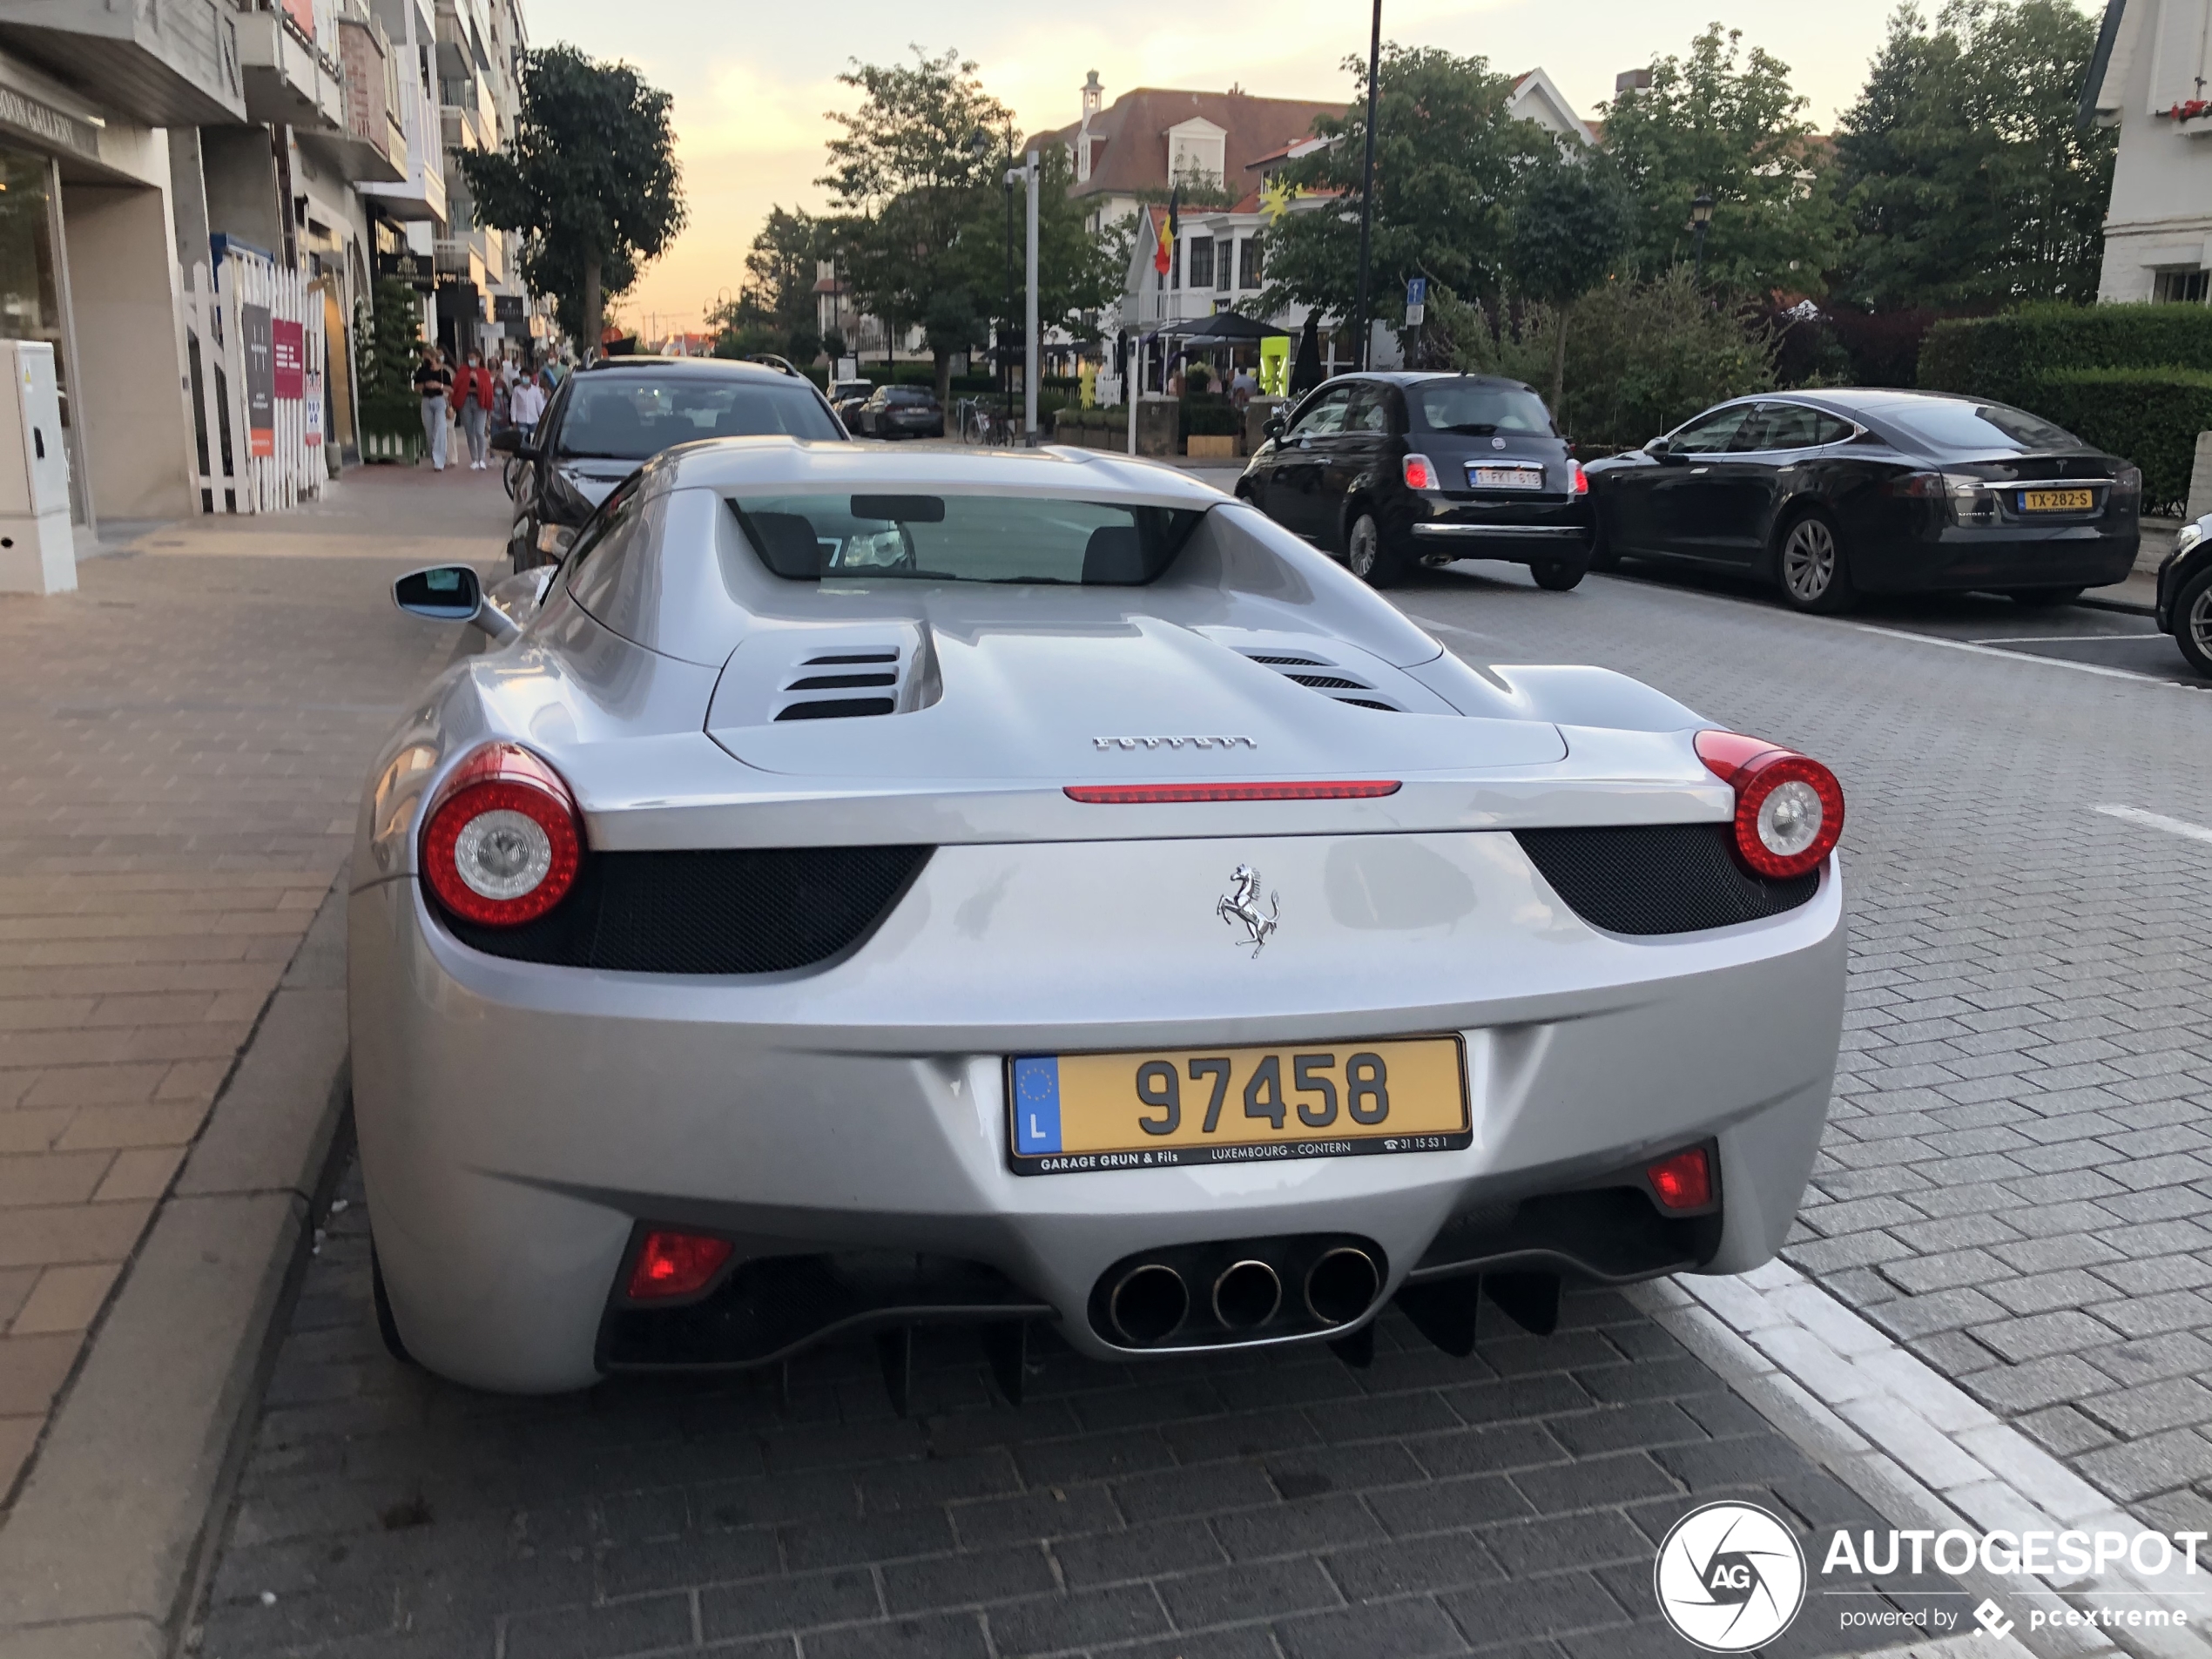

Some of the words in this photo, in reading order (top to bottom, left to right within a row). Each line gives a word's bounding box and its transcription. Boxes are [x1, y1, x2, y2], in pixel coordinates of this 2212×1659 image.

[2030, 493, 2087, 507] TX-282-S
[1136, 1052, 1389, 1136] 97458
[1030, 1114, 1046, 1139] L
[1211, 1145, 1288, 1160] LUXEMBOURG
[1298, 1142, 1351, 1155] CONTERN
[1400, 1139, 1411, 1149] 31
[1415, 1138, 1426, 1149] 15
[1428, 1137, 1440, 1148] 53
[1443, 1137, 1447, 1147] 1
[1041, 1156, 1096, 1170] GARAGE
[1100, 1153, 1139, 1166] GRUN
[1143, 1152, 1153, 1163] &
[1157, 1150, 1178, 1163] Fils
